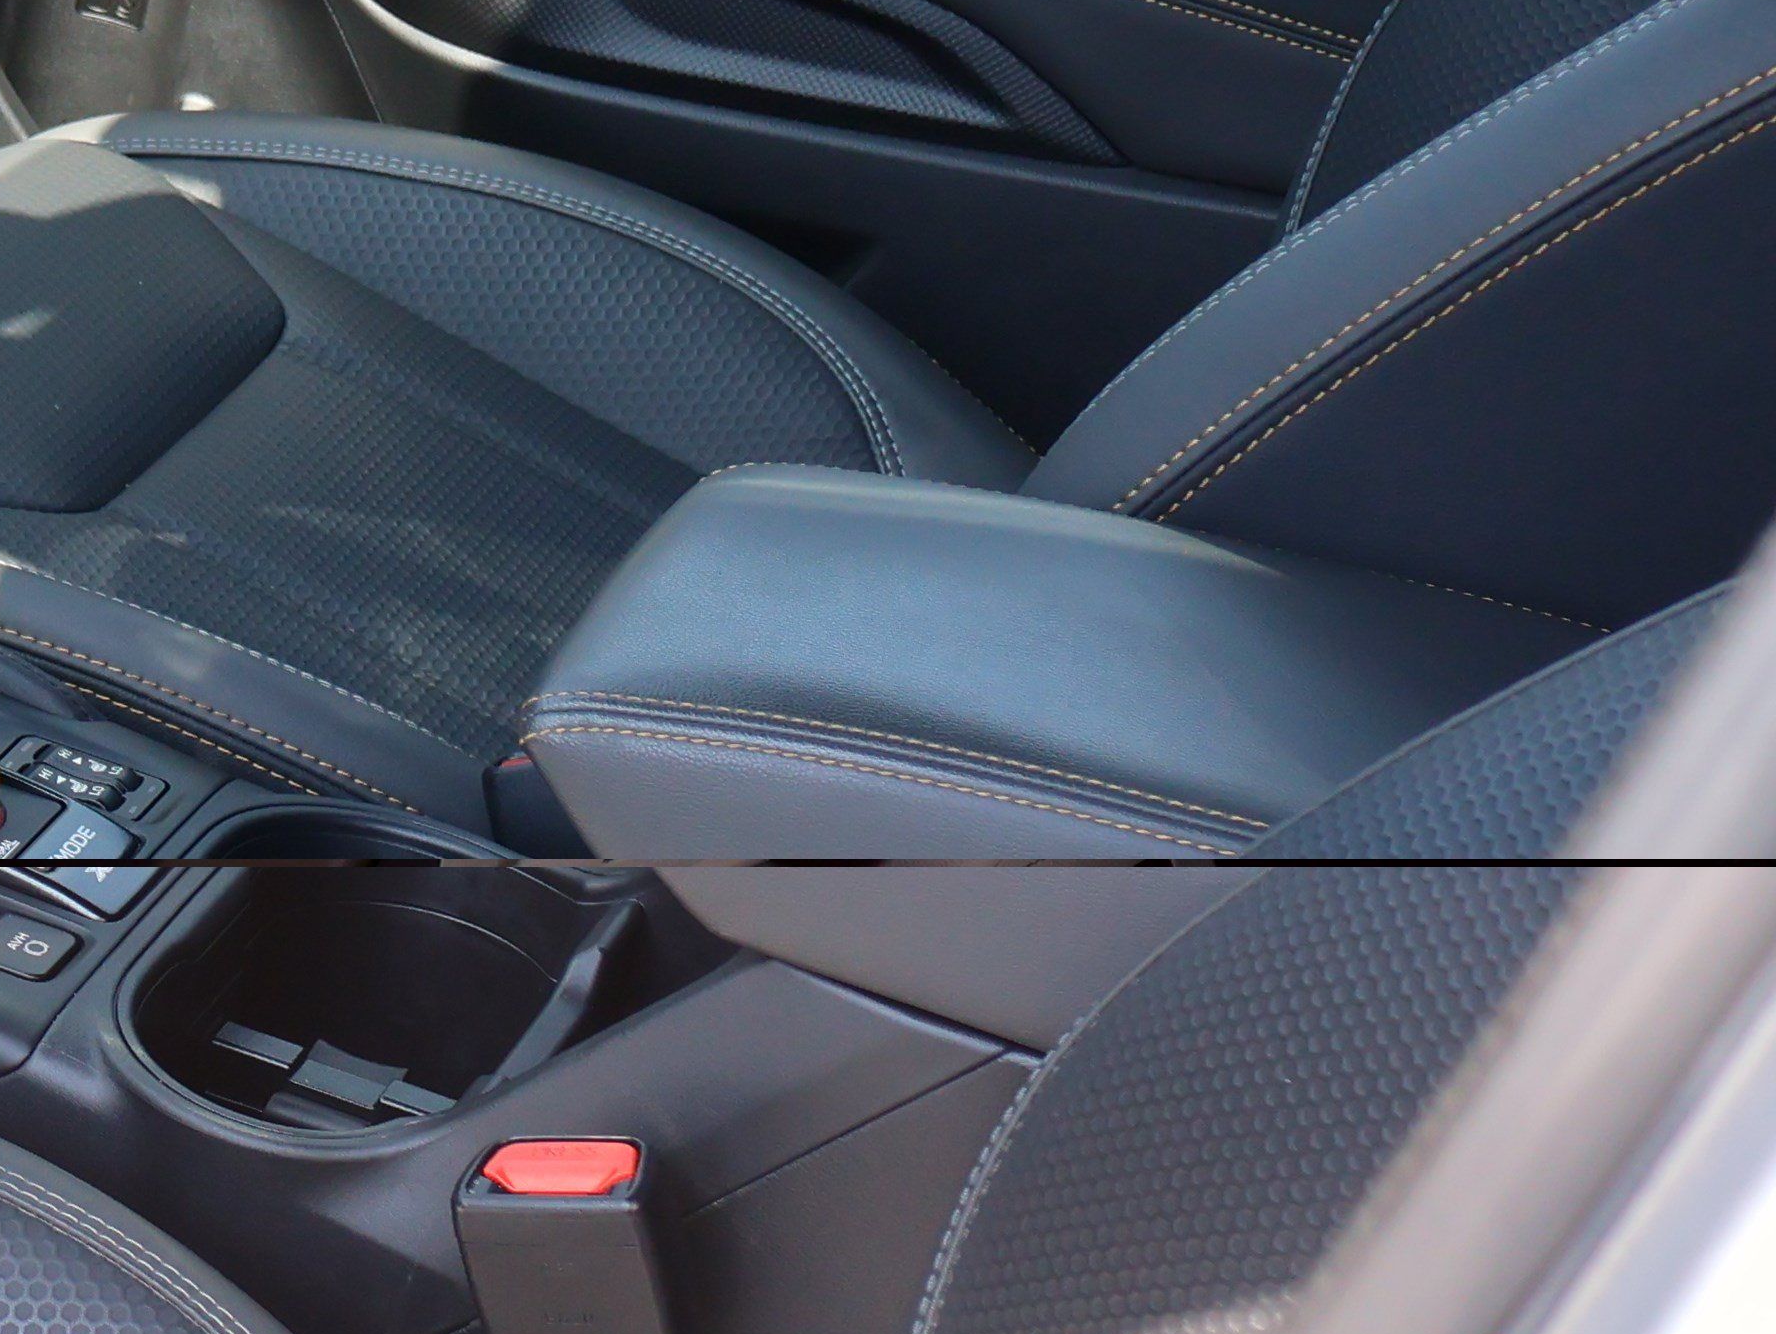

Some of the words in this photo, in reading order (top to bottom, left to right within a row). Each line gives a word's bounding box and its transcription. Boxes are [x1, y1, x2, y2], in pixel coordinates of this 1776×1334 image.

[57, 748, 73, 760] HI
[38, 768, 54, 780] HI
[7, 932, 31, 951] AVH
